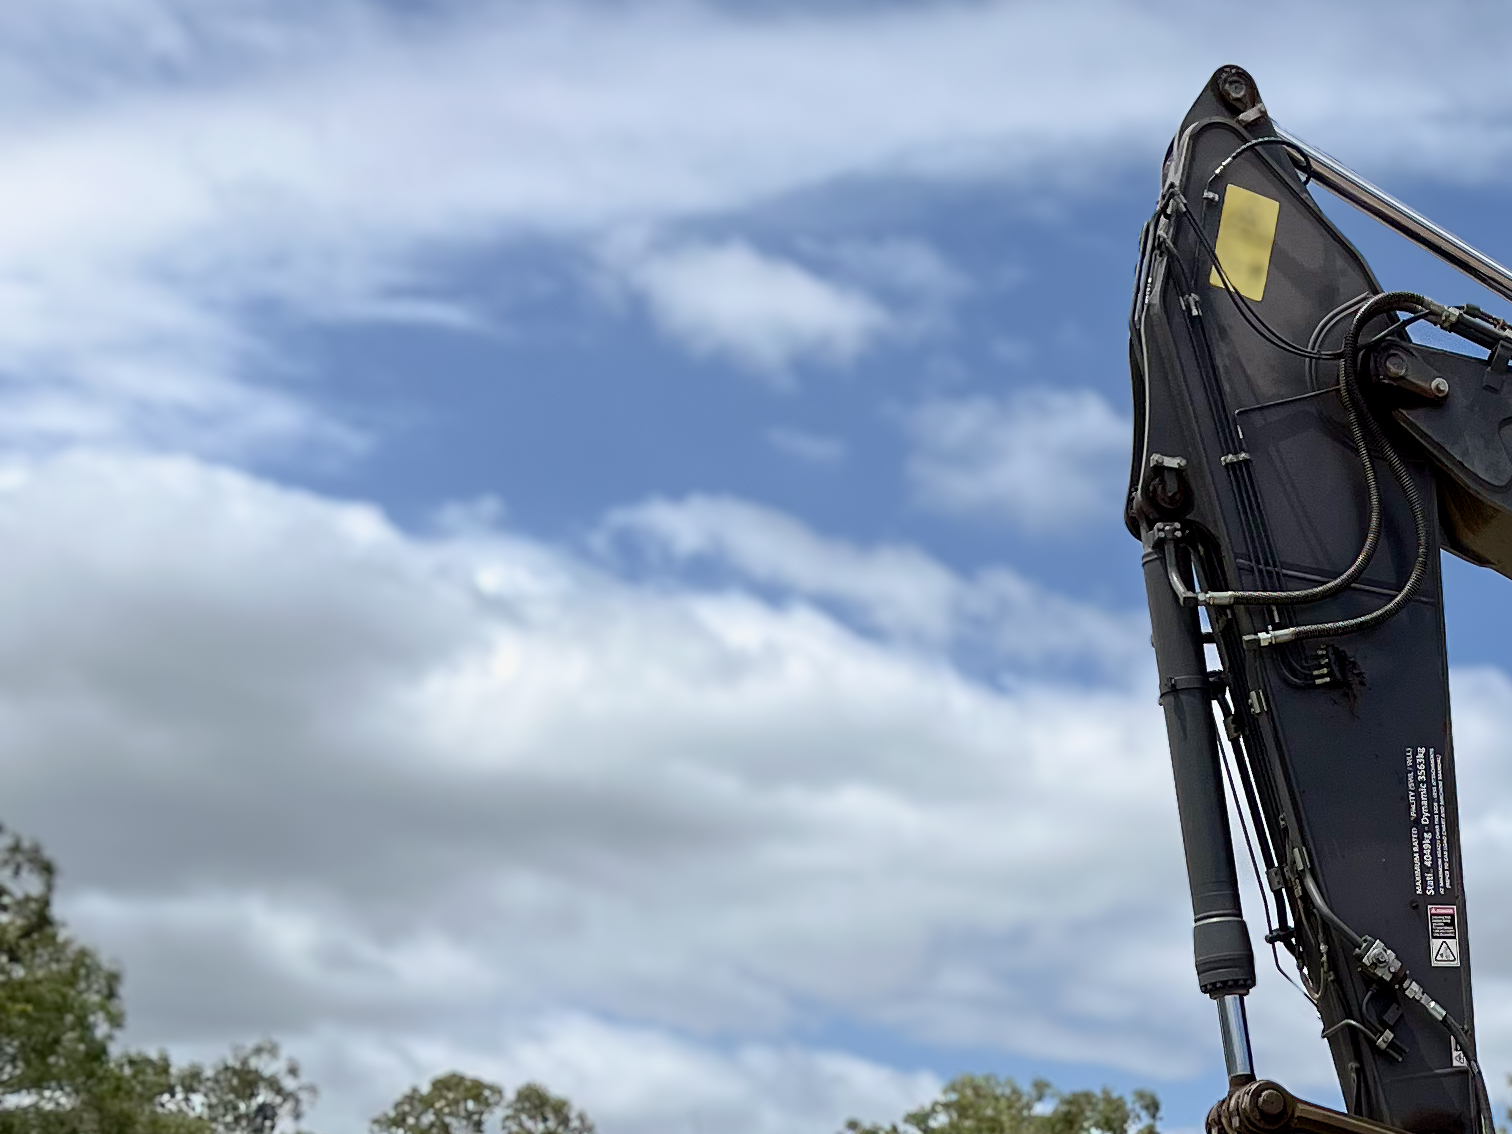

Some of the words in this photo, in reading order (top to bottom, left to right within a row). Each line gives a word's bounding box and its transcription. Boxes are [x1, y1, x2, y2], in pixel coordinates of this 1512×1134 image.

[1416, 747, 1427, 781] 3563kg
[1418, 783, 1430, 825] Dynamic
[1422, 832, 1433, 867] 4049kg
[1413, 853, 1422, 894] MAXIMUM
